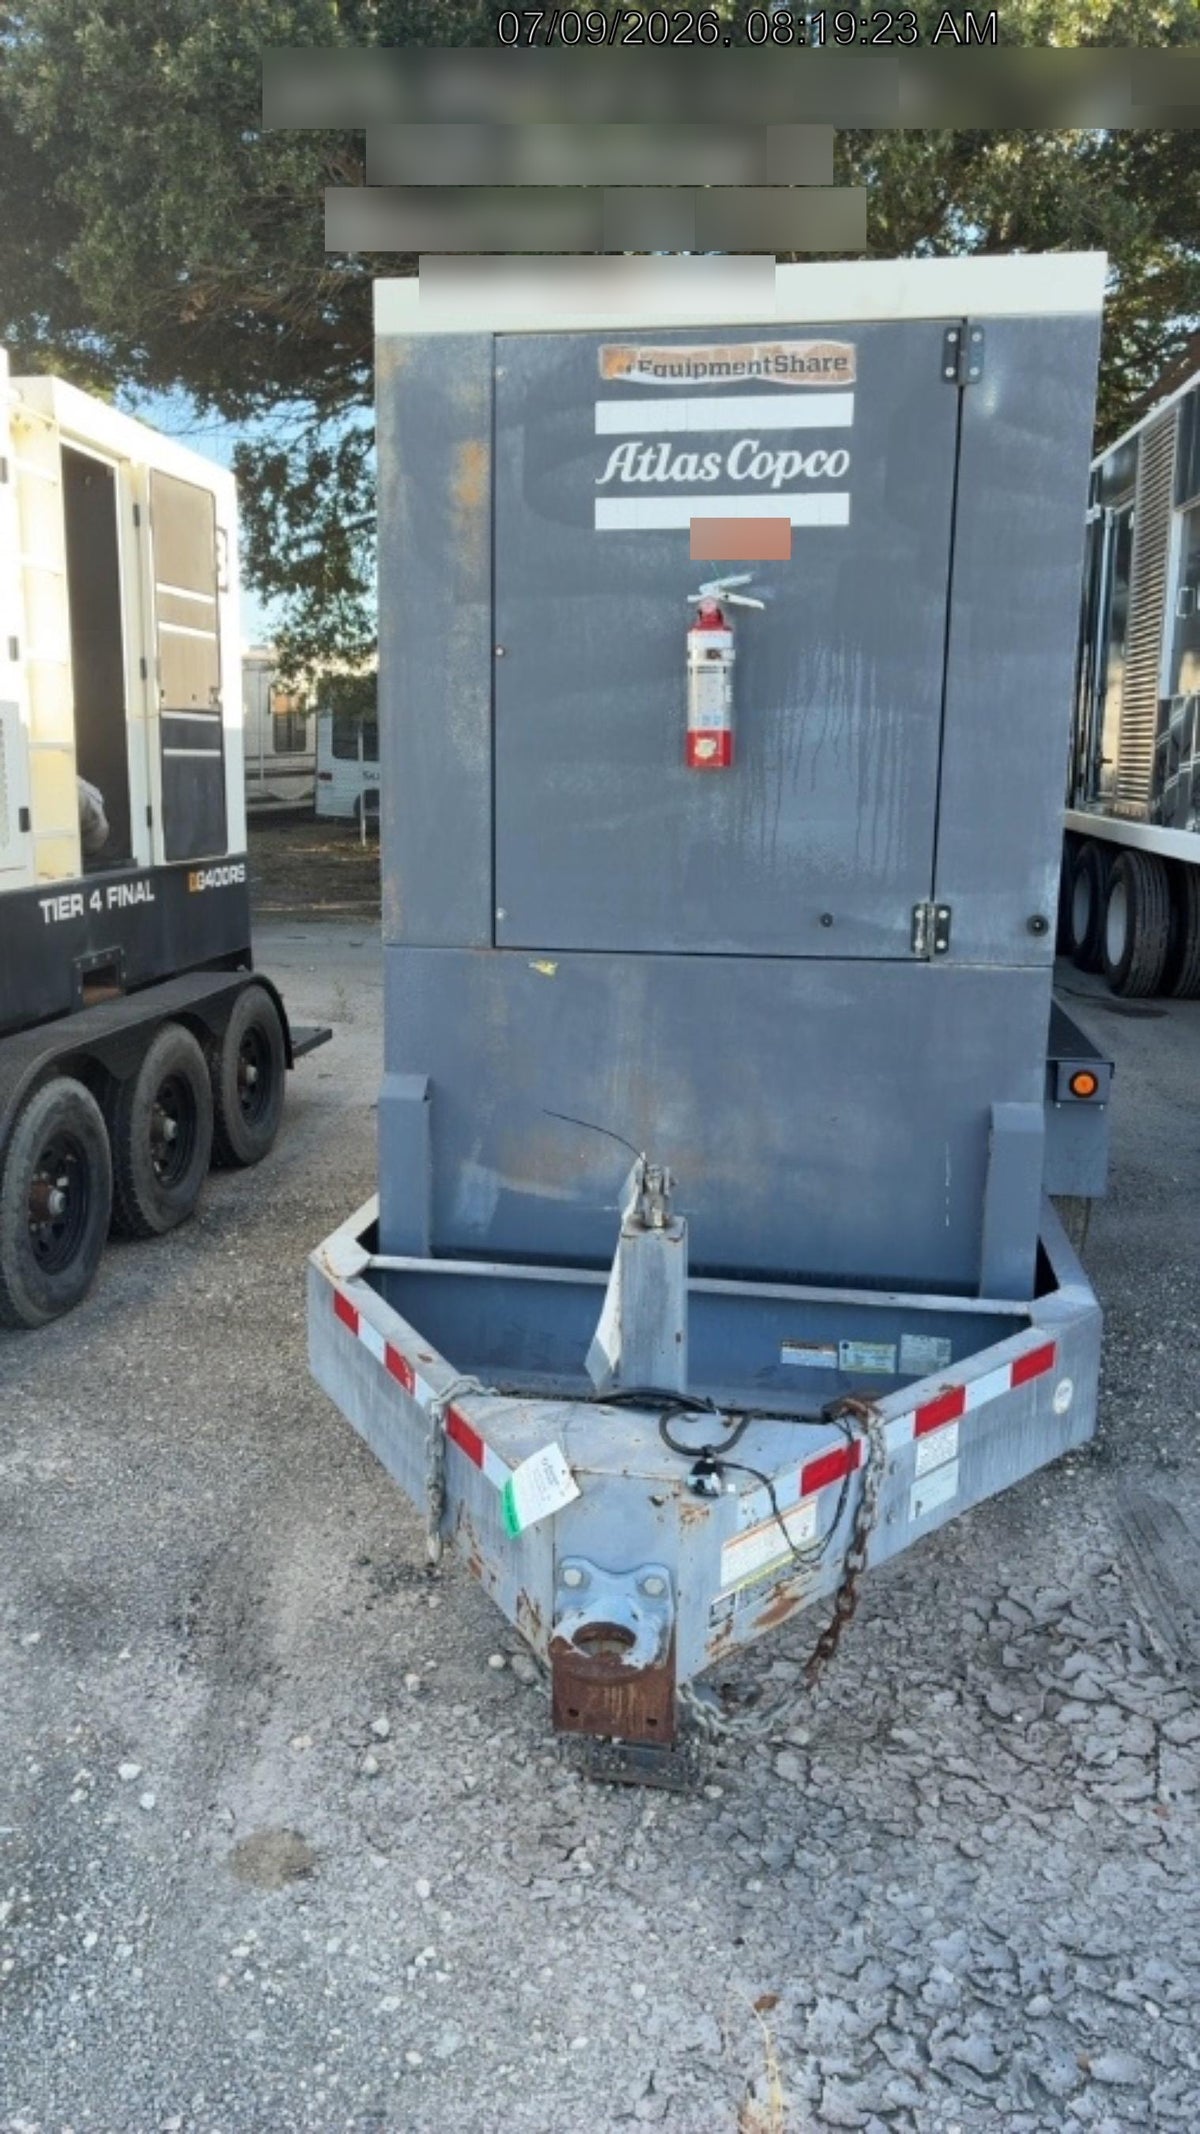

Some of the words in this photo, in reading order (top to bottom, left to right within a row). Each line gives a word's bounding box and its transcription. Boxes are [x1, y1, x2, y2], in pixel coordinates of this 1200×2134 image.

[595, 441, 722, 485] Atlas
[727, 438, 850, 488] Copco
[39, 893, 84, 924] TIER
[89, 888, 103, 912] 4
[106, 879, 155, 910] FINAL
